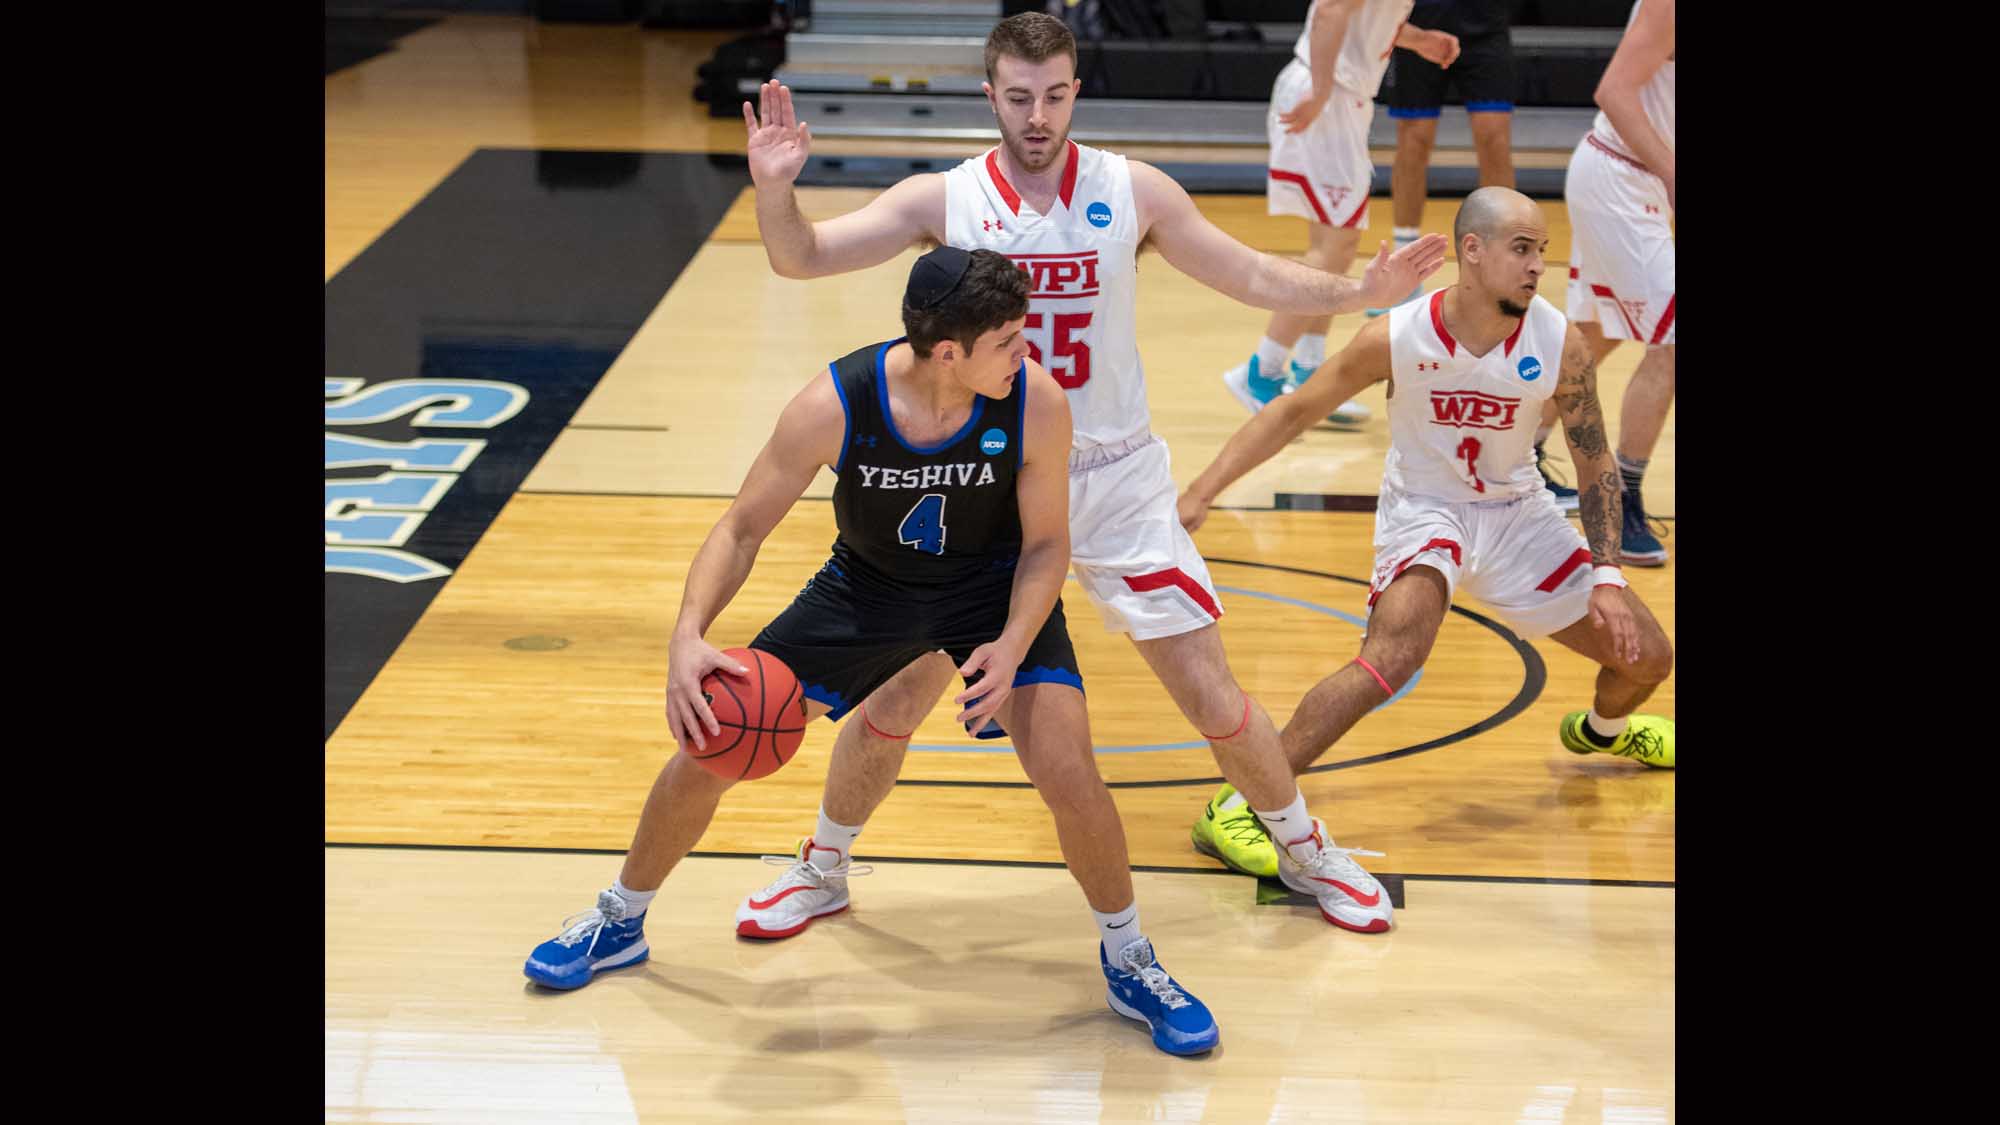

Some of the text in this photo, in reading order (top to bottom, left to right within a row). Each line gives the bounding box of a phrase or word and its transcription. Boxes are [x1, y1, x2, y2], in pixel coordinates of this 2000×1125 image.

[1089, 213, 1111, 222] NCAA
[1430, 396, 1520, 425] WPI
[983, 440, 1006, 449] NCAA
[858, 462, 996, 489] YESHIVA
[897, 493, 947, 555] 4
